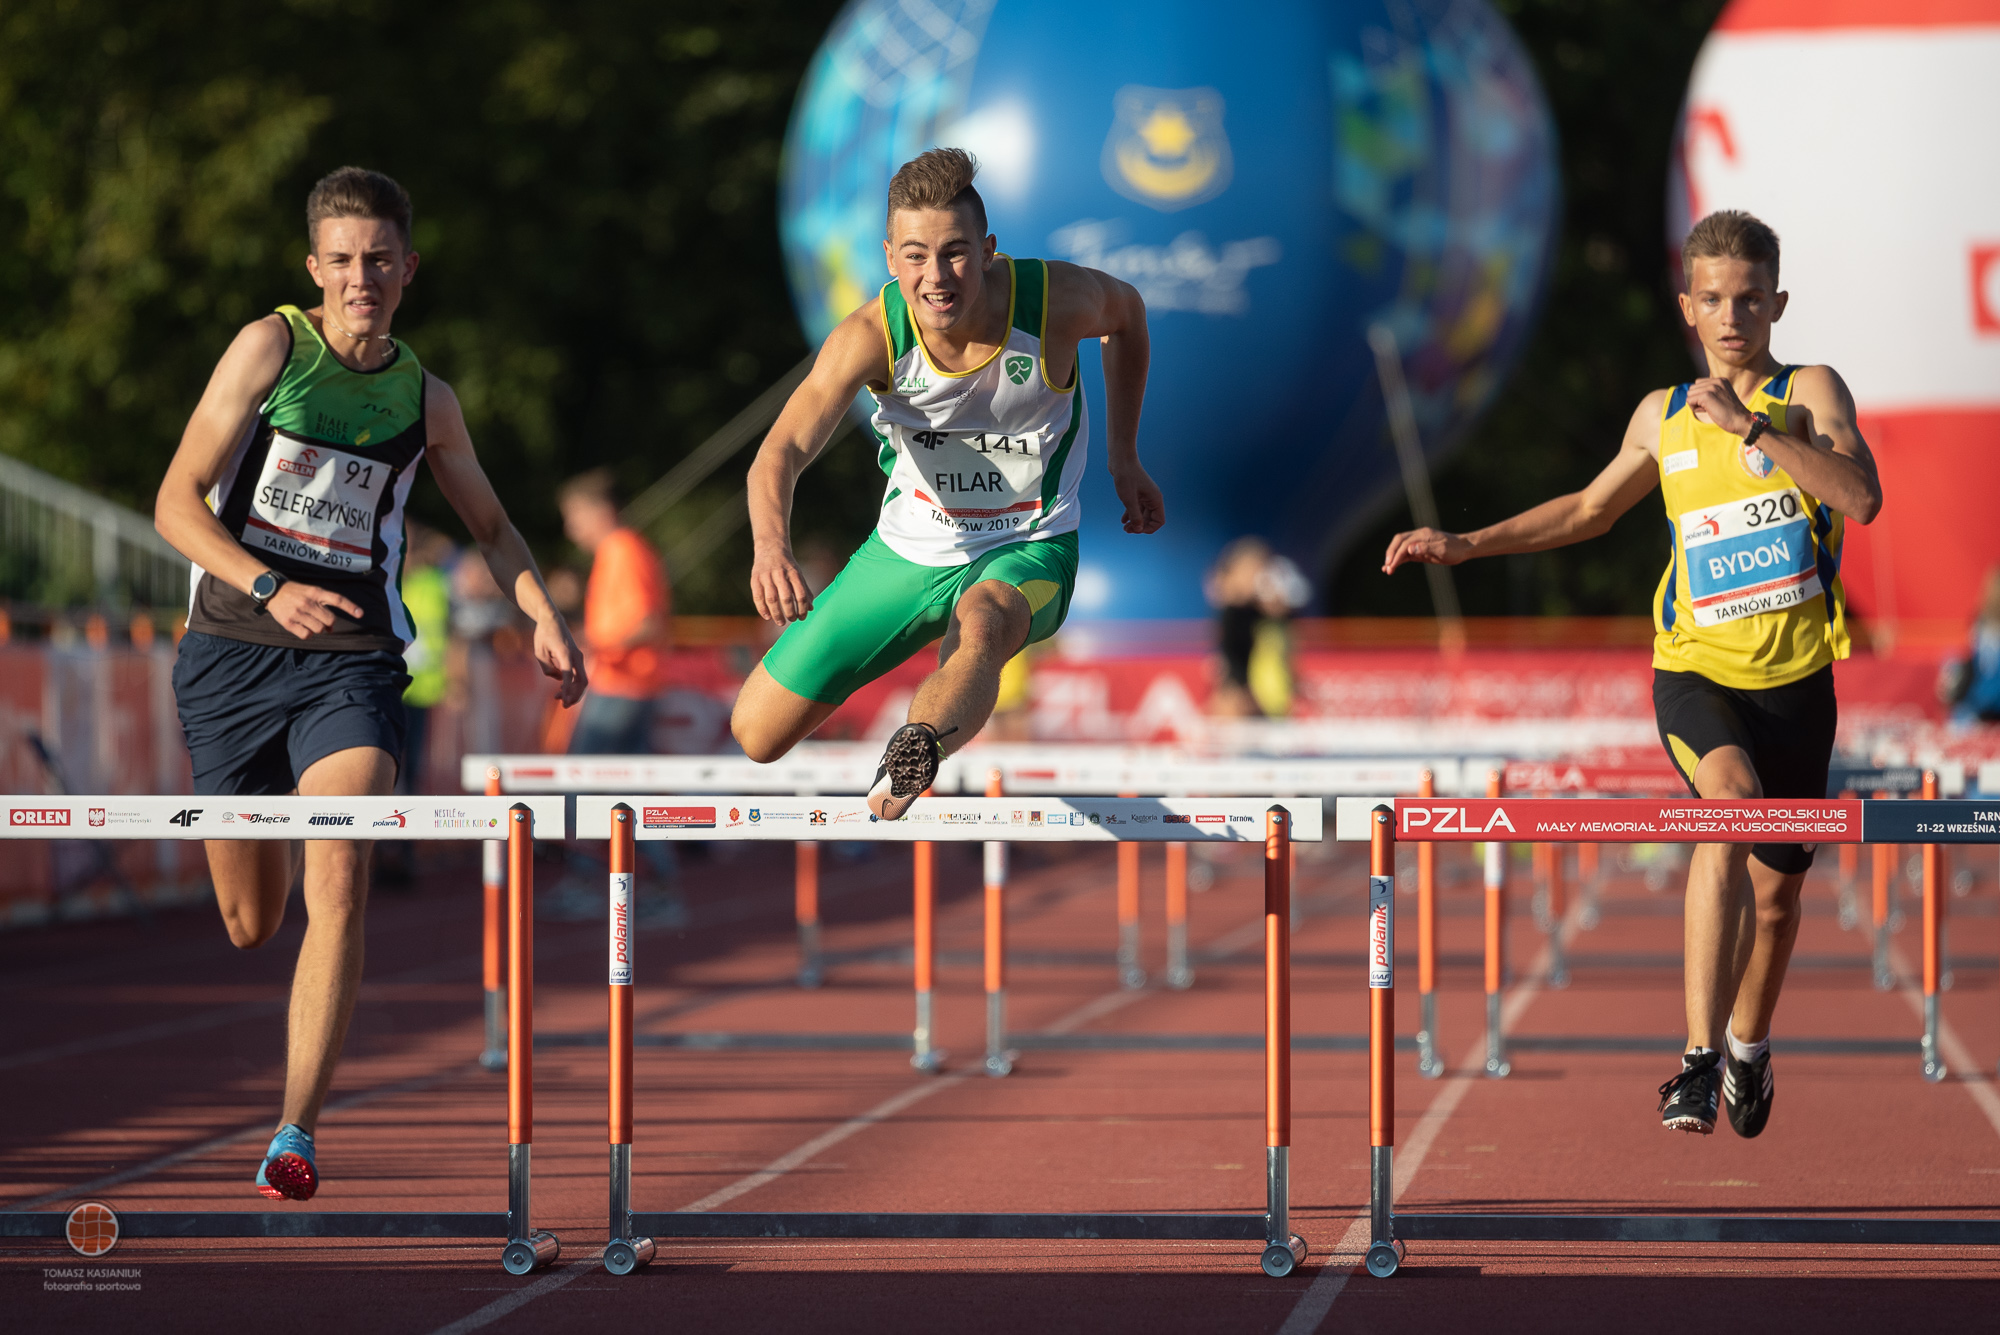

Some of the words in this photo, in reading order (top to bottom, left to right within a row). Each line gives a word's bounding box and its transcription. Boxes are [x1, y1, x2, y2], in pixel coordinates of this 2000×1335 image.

[318, 412, 349, 433] BIAŁE
[912, 431, 949, 450] 4F
[973, 433, 1033, 456] 141
[279, 461, 316, 477] ORLEN
[344, 460, 374, 490] 91
[935, 471, 1004, 493] FILAR
[259, 486, 372, 532] SELERZYŃSKI
[1743, 494, 1797, 527] 320
[987, 517, 1020, 532] 2019
[1685, 528, 1711, 542] polanik
[264, 535, 321, 560] TARNÓW
[325, 552, 352, 568] 2019
[1708, 537, 1791, 580] BYDOŃ
[1715, 596, 1771, 620] TARNÓW
[1775, 587, 1805, 606] 2019
[12, 811, 67, 824] ORLEN
[169, 809, 204, 827] 4F
[308, 816, 354, 826] 4MOVE
[434, 808, 456, 818] NESTLÉ
[1403, 807, 1516, 833] PZLA
[1659, 808, 1764, 819] MISTRZOSTWA
[1768, 808, 1819, 819] POLSKI
[1822, 809, 1847, 819] U16
[434, 819, 470, 828] HEALTHIER
[472, 819, 487, 828] KIDS
[1536, 822, 1577, 832] MAŁY
[1580, 822, 1657, 832] MEMORIAŁ
[1659, 822, 1728, 832] JANUSZA
[1731, 820, 1847, 833] KUSOCIŃSKIEGO
[1916, 823, 1945, 833] 21-22
[1946, 822, 1997, 833] WRZEŚNIA
[613, 901, 630, 964] polanik
[1373, 904, 1389, 967] polanik
